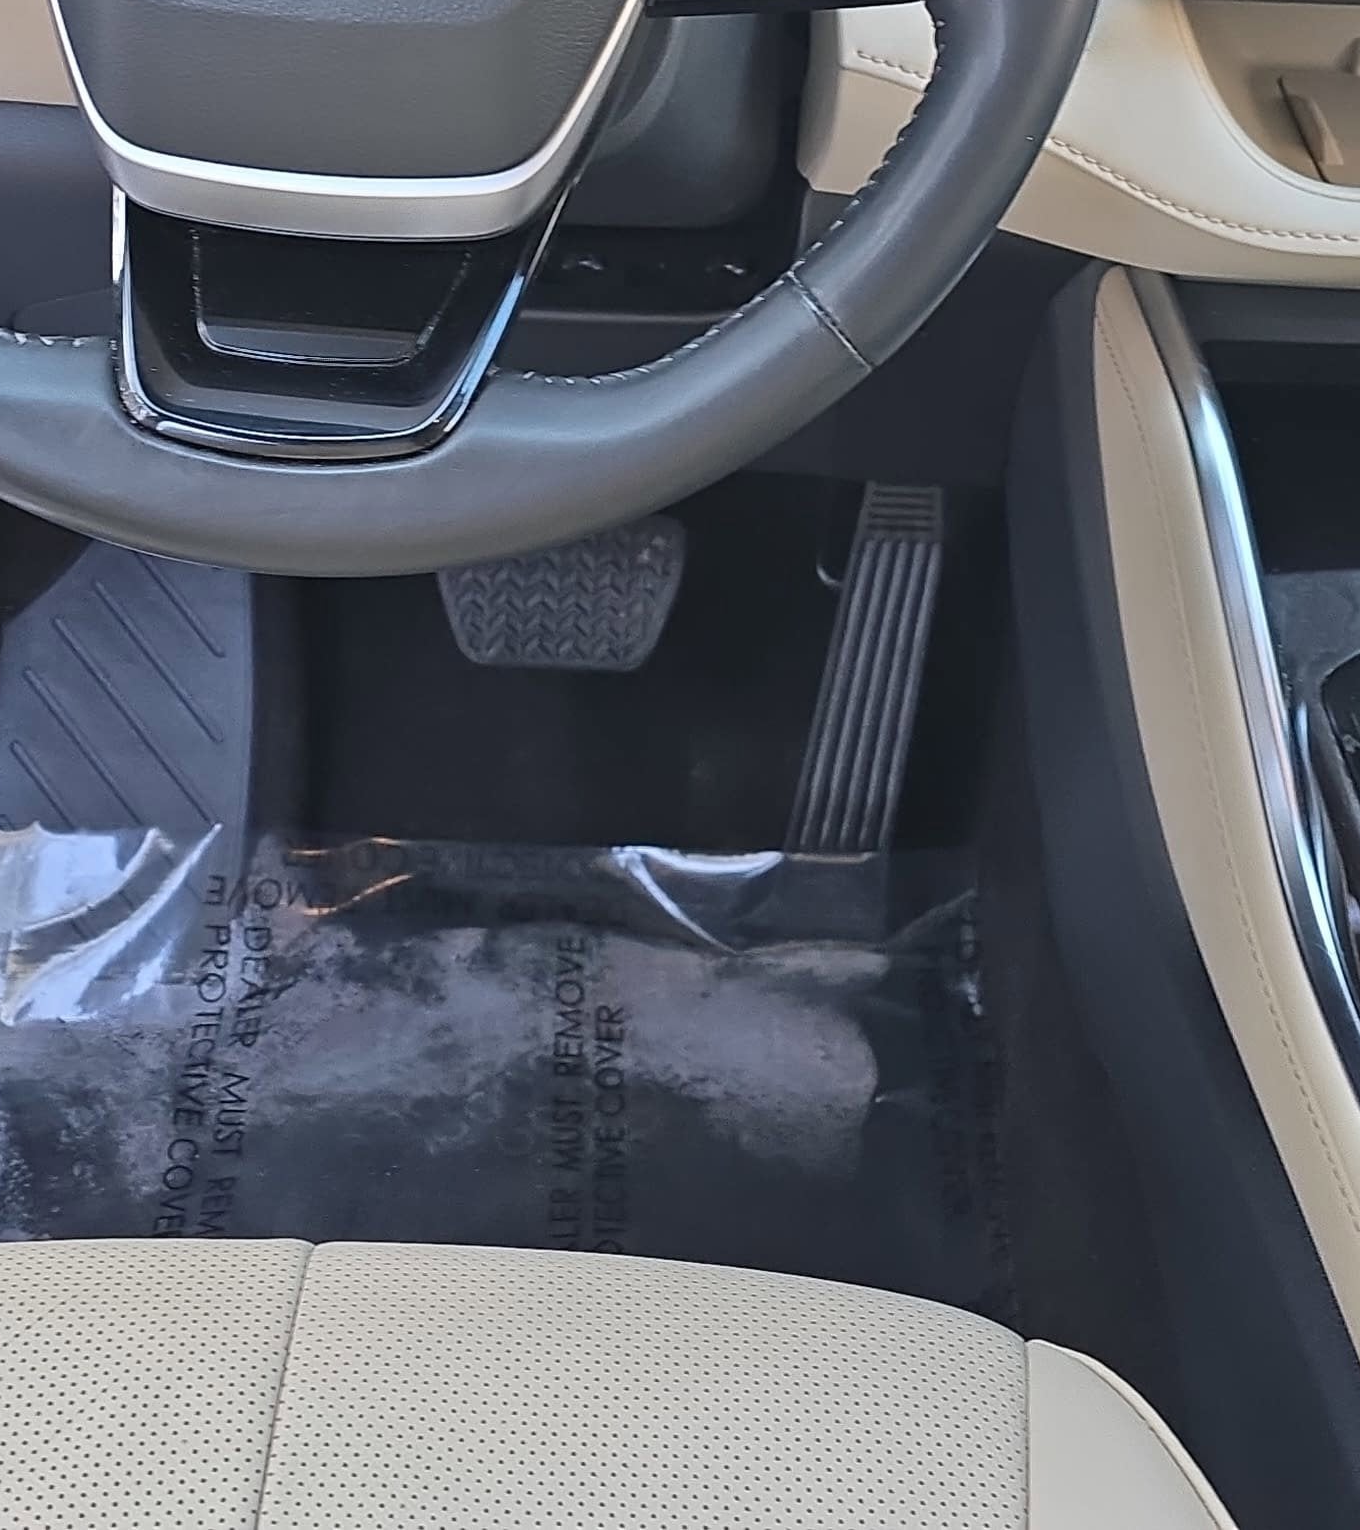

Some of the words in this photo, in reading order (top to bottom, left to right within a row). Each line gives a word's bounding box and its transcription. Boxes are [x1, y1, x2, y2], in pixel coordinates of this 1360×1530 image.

[173, 923, 232, 1127] PROTECTIVE
[551, 936, 586, 1076] REMOVE
[593, 1005, 627, 1120] COVER
[212, 1072, 251, 1156] MUST
